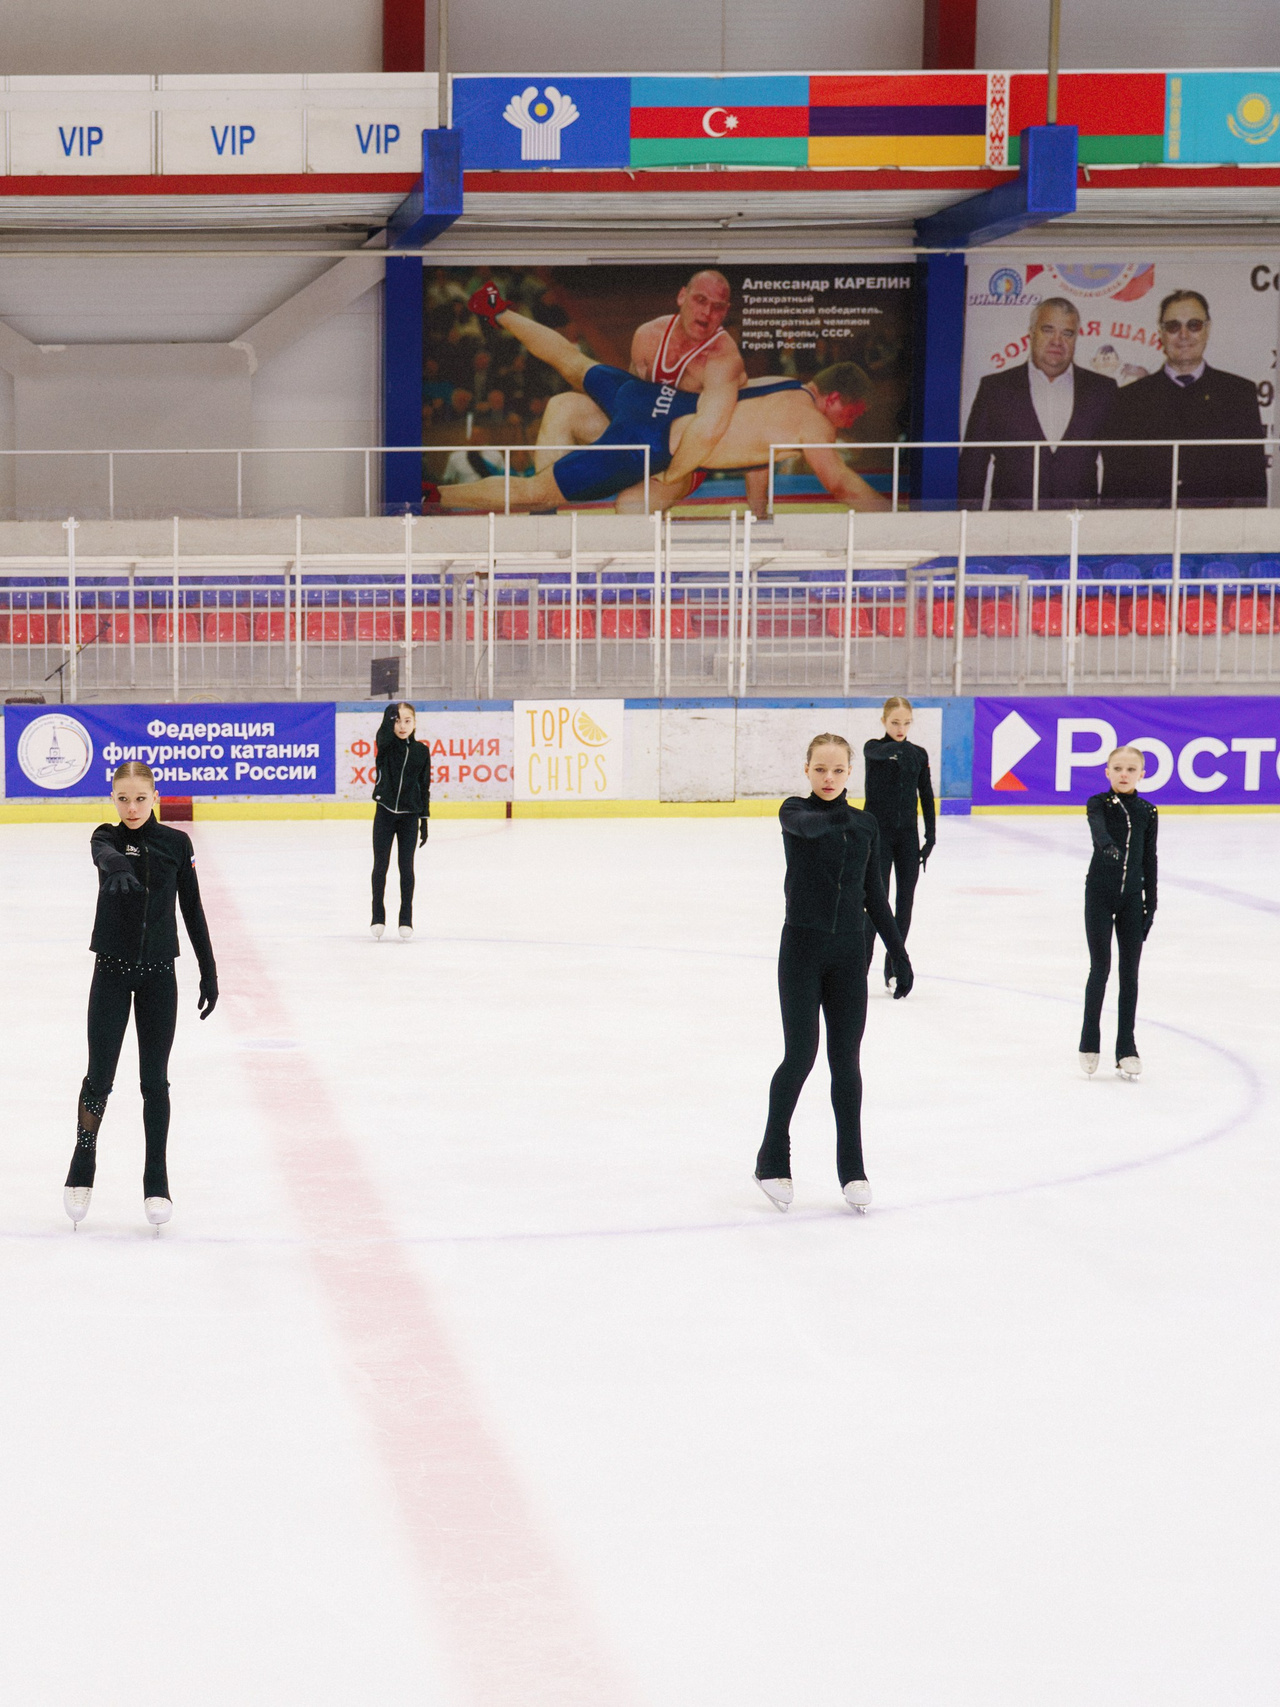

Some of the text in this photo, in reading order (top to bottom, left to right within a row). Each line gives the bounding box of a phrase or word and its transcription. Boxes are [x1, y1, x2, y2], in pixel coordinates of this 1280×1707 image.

[59, 126, 103, 156] VIP
[211, 125, 255, 155] VIP
[355, 124, 400, 154] VIP
[742, 277, 911, 291] Александр КАРЕЛИН
[742, 294, 814, 304] Трехкратный
[742, 306, 815, 315] олимпийский
[742, 318, 820, 327] Многократный
[742, 340, 816, 350] Герой России
[652, 386, 677, 417] BUL
[147, 719, 275, 741] Федерация
[526, 707, 570, 749] TOP
[102, 741, 320, 765] фигурного катания
[1055, 718, 1280, 793] Рост
[151, 766, 228, 782] оньках
[235, 763, 317, 781] России
[528, 752, 607, 795] CHIPS
